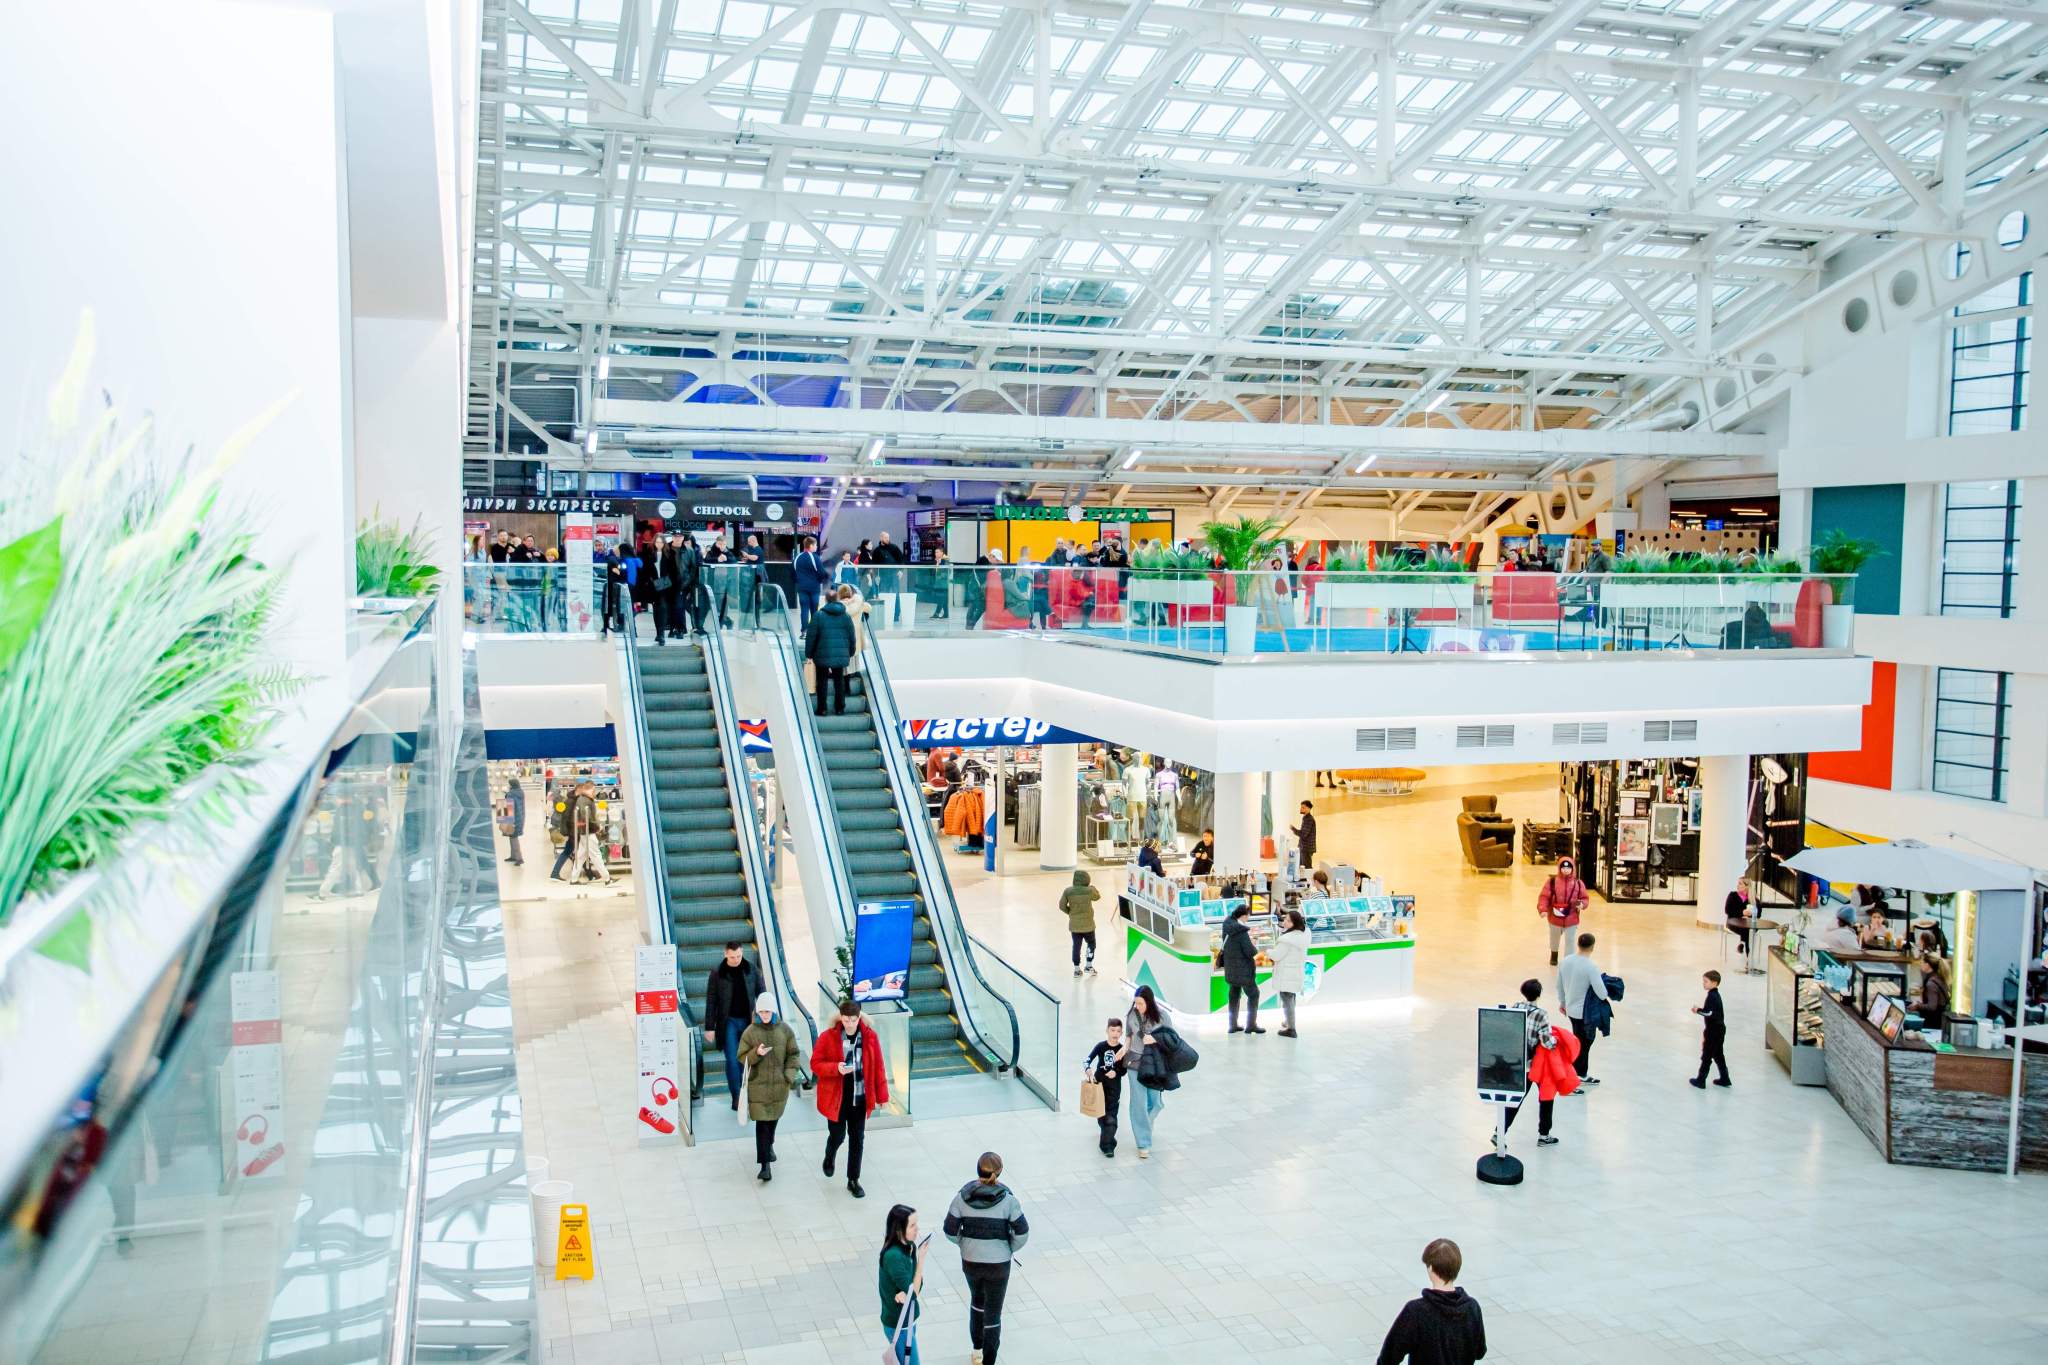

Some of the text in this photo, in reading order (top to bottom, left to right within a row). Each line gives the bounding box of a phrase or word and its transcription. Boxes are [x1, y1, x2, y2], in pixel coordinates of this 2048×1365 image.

[527, 499, 611, 512] ЭКСПРЕСС
[994, 505, 1150, 522] UNION PIZZA
